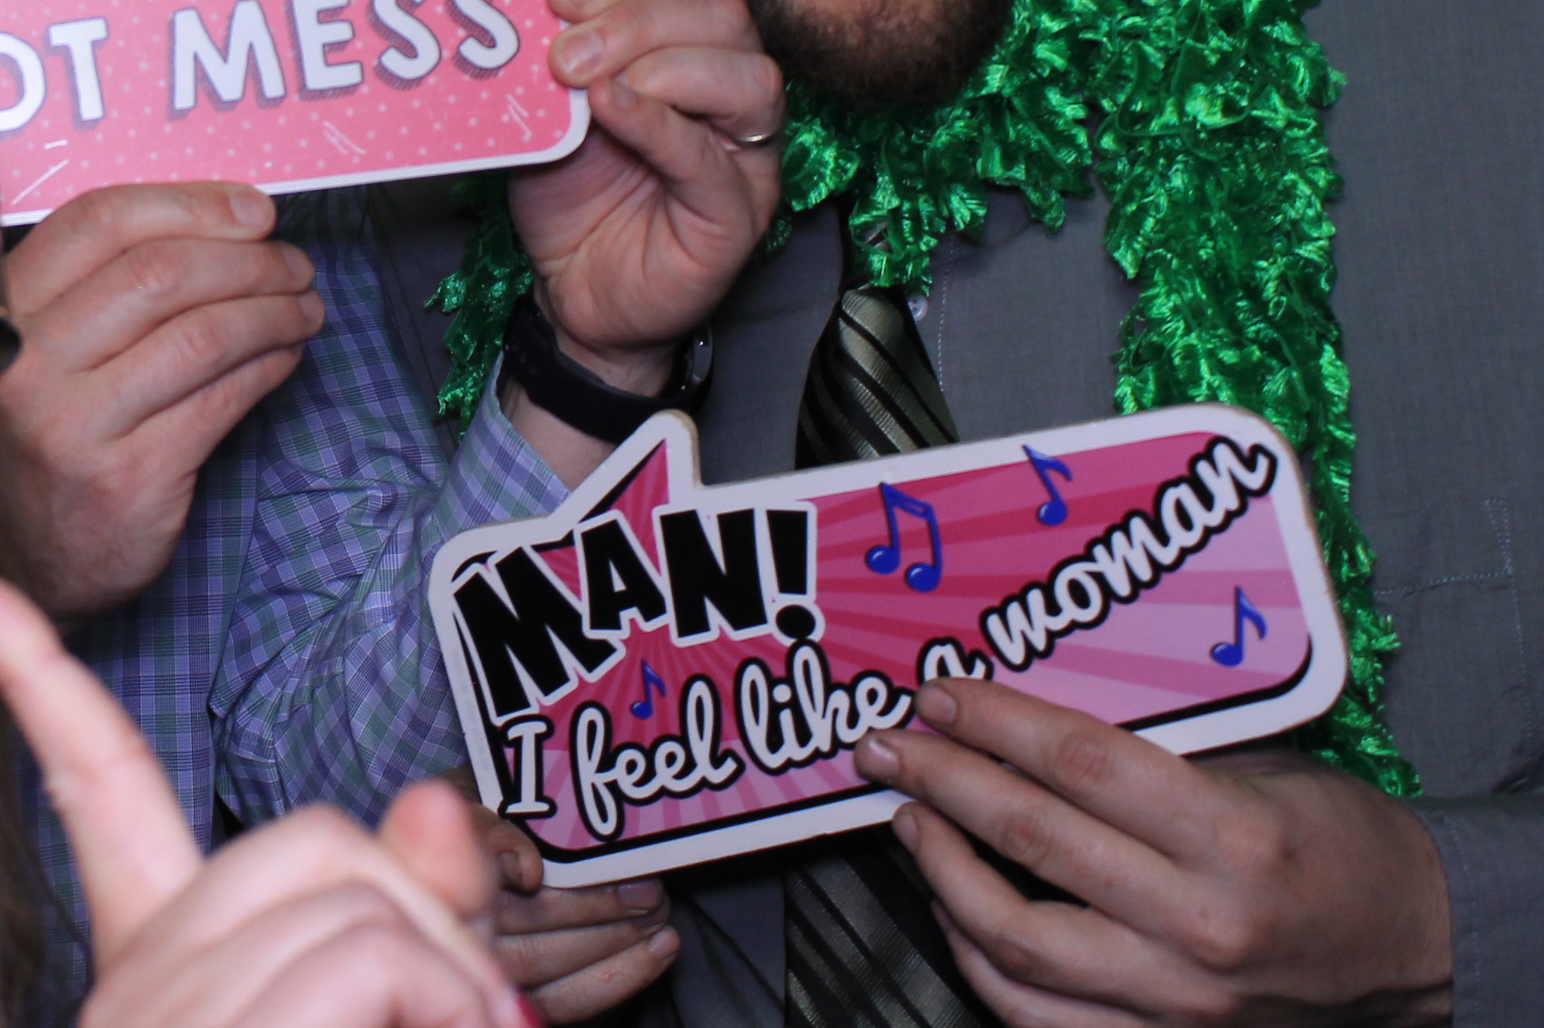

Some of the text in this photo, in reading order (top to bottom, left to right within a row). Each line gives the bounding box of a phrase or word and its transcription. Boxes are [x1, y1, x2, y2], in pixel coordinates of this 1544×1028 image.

[452, 507, 816, 718] MAN!
[504, 719, 552, 815] I
[574, 671, 738, 840] feel
[740, 641, 915, 772] like
[984, 436, 1272, 668] woman
